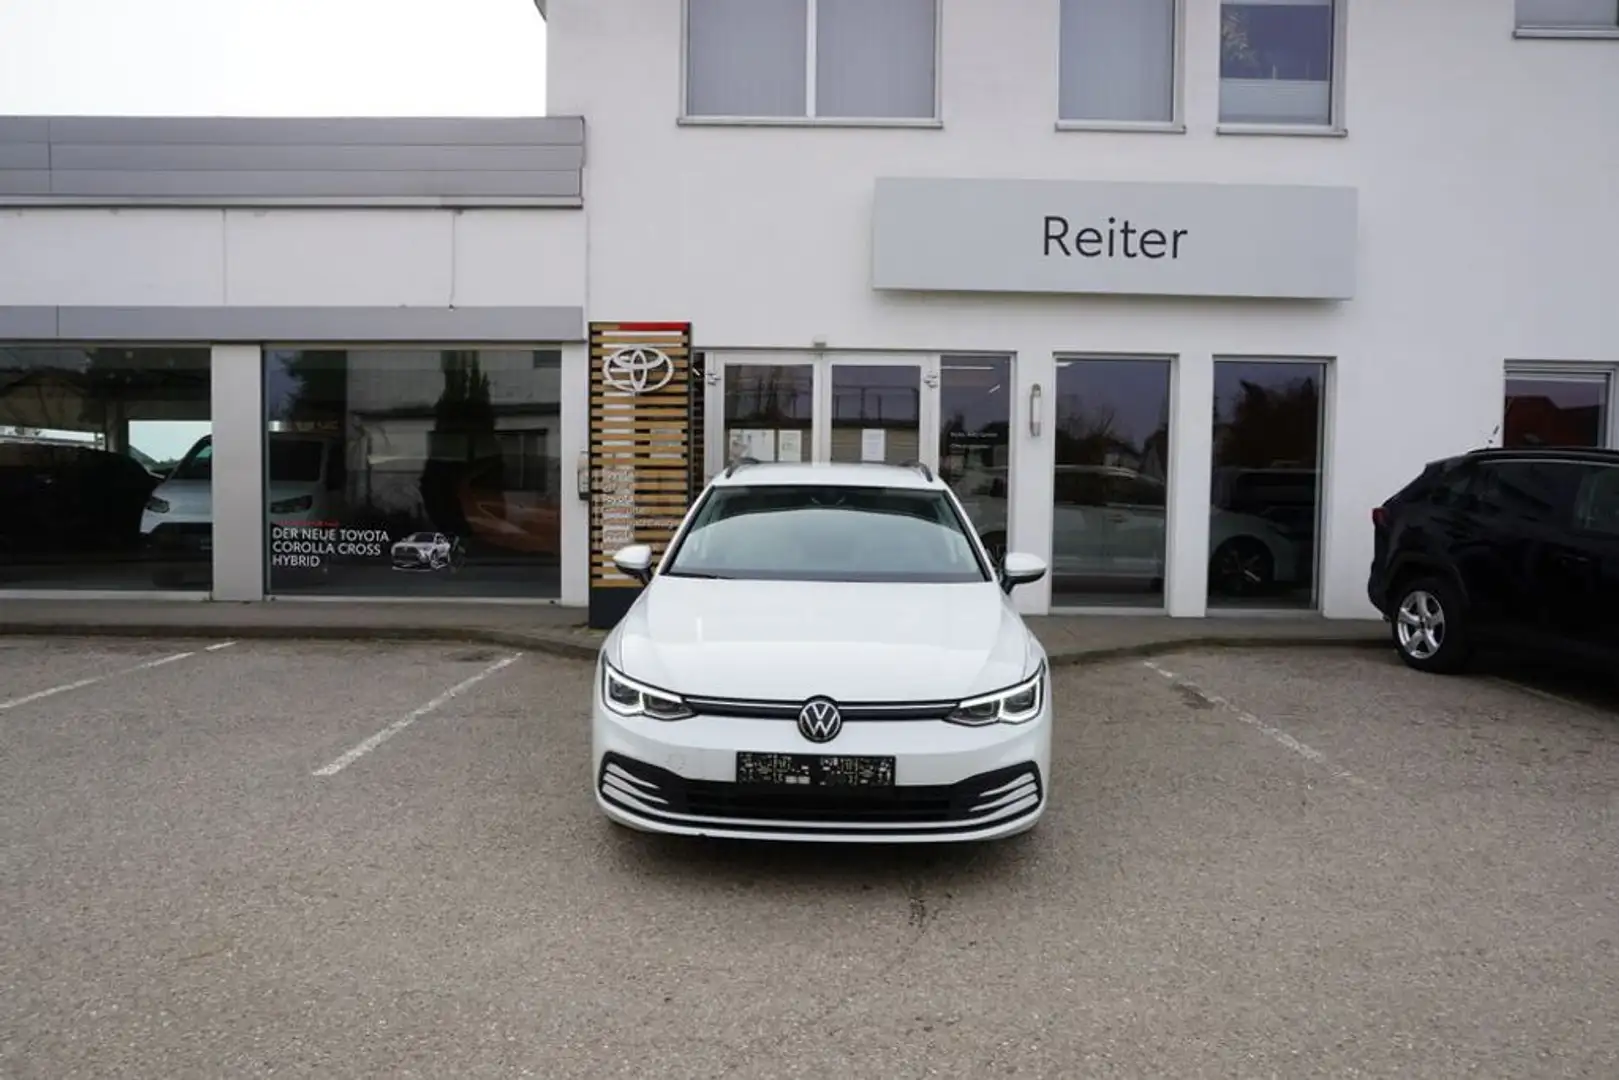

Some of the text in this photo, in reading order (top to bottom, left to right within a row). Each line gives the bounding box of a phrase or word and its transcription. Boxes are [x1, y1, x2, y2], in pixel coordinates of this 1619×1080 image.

[1044, 216, 1188, 259] Reiter
[272, 527, 389, 542] DER NEUE TOYOTA
[272, 540, 381, 556] COROLLA CROSS
[272, 554, 320, 568] HYBRID
